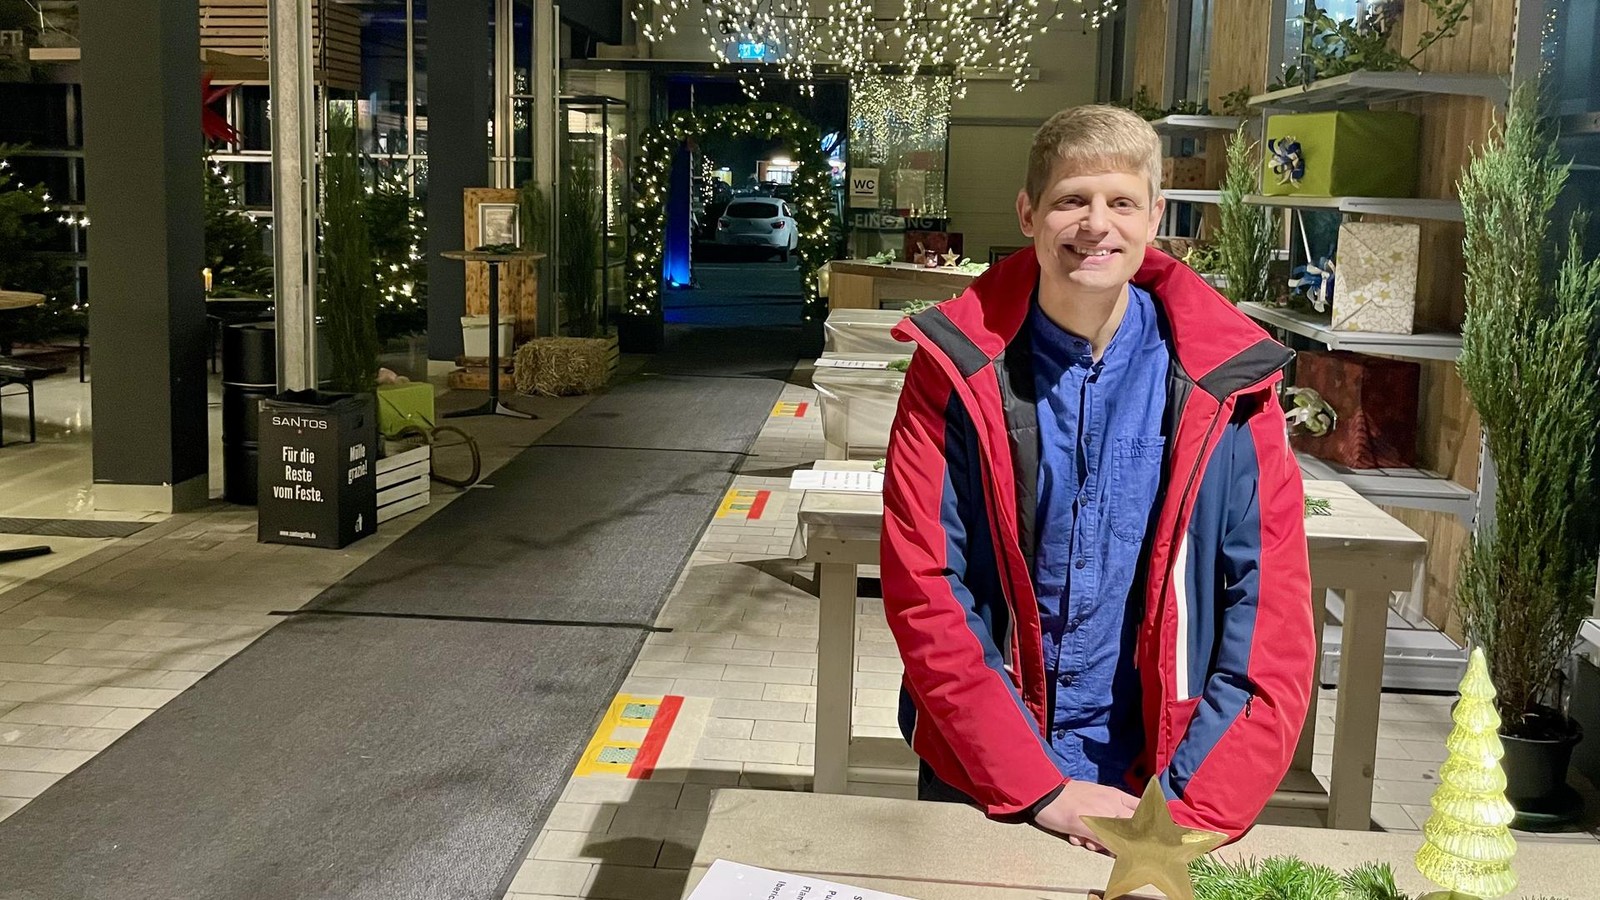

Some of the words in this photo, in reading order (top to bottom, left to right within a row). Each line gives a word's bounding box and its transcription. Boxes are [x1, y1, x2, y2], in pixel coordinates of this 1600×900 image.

[853, 179, 875, 190] WC
[272, 416, 328, 430] SANTOS
[282, 446, 299, 462] Für
[300, 447, 315, 464] die
[285, 465, 312, 482] Reste
[273, 486, 293, 499] vom
[295, 484, 324, 502] Feste.
[767, 880, 787, 900] Iberic
[824, 890, 837, 900] Pu
